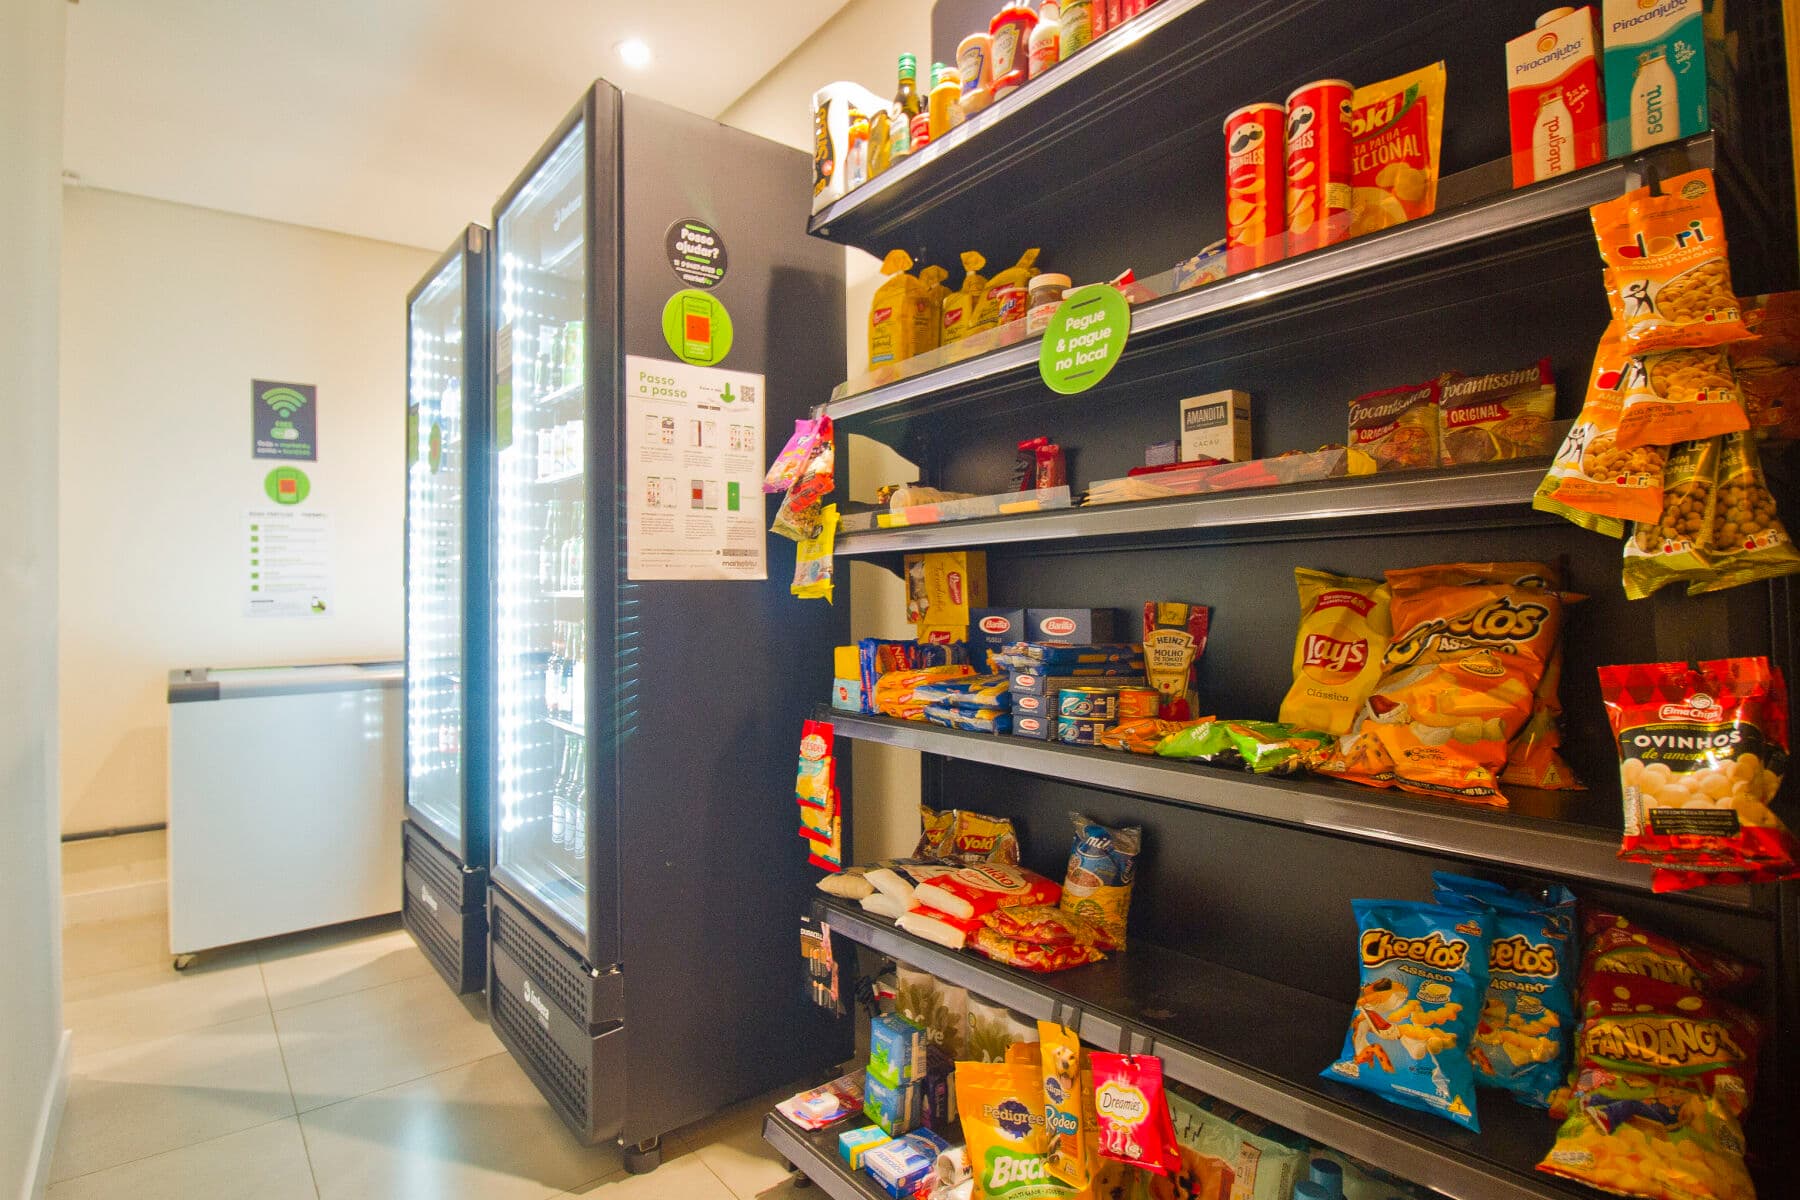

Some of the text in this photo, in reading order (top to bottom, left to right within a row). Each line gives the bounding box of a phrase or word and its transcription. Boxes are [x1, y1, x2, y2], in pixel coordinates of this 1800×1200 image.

[1515, 40, 1582, 75] Piracanjuba
[1640, 84, 1663, 135] semi
[681, 228, 714, 246] Posso
[1618, 220, 1705, 258] dori
[675, 240, 720, 259] ajudar?
[1065, 310, 1106, 332] Pegue
[1056, 327, 1112, 353] & pague
[1055, 343, 1108, 372] no local
[639, 371, 675, 386] Passo
[640, 385, 648, 394] a
[652, 386, 688, 399] passo
[1186, 405, 1225, 425] AMANDITA
[1450, 404, 1501, 424] ORIGINAL
[985, 620, 1008, 629] Barilla
[1047, 621, 1074, 630] Barilla
[1157, 635, 1184, 645] HEINZ
[1154, 649, 1184, 657] MOLHO
[1305, 635, 1365, 672] Lay's
[1634, 730, 1741, 748] OVINHOS
[1641, 747, 1658, 760] de
[964, 836, 994, 850] Yoki
[1361, 931, 1467, 968] Cheetos
[1399, 963, 1453, 983] ASSADO
[1103, 1093, 1141, 1111] Dreamies
[984, 1105, 1044, 1125] Pedigree
[1045, 1105, 1077, 1131] Rodeo
